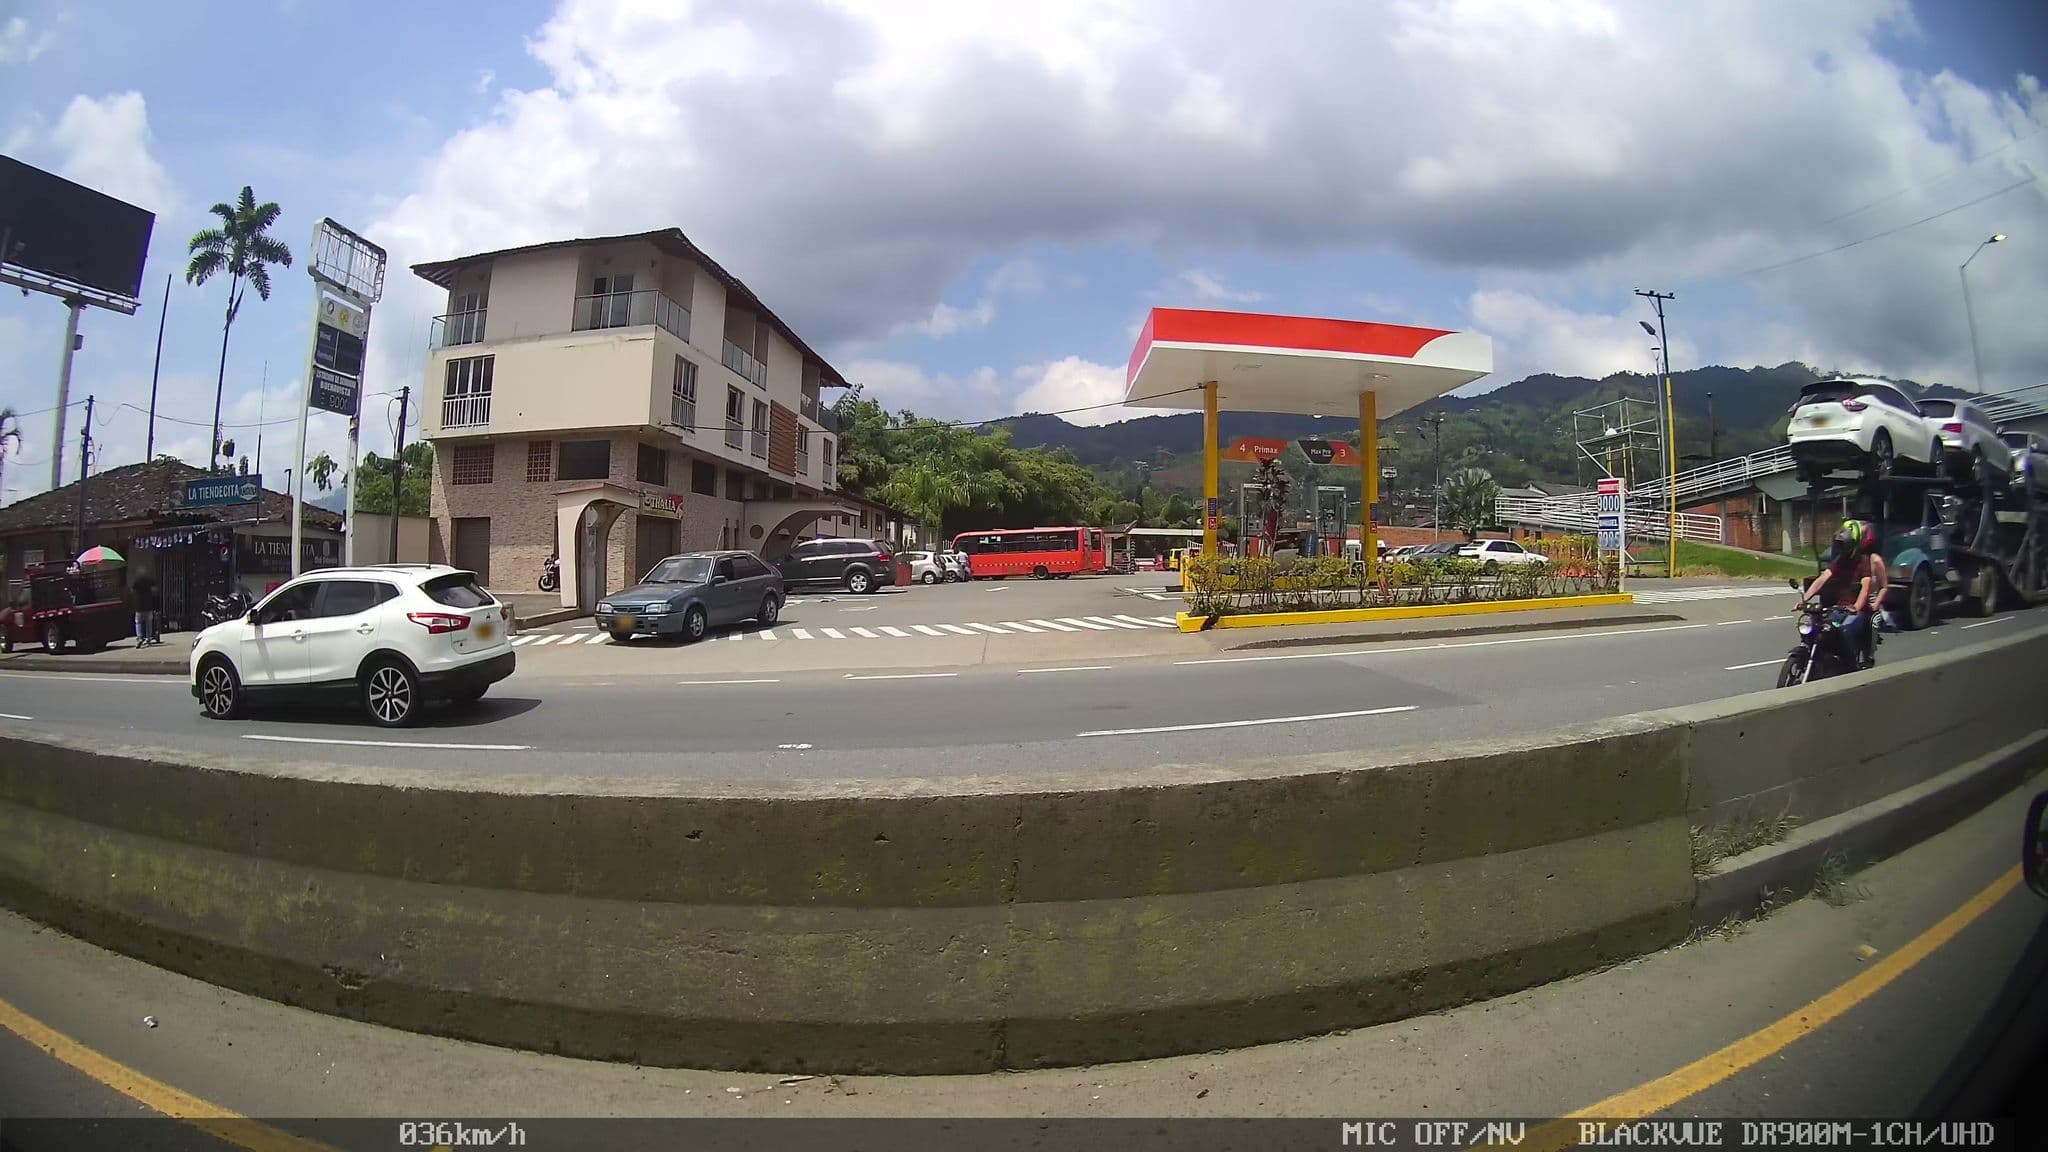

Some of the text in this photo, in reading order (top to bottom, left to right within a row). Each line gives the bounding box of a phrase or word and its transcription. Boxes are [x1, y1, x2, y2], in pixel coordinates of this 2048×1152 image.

[1239, 443, 1246, 453] 4
[1254, 445, 1278, 454] Primax
[1340, 449, 1346, 457] 3
[188, 487, 197, 500] LA
[199, 484, 240, 499] TIENDECITA
[1597, 495, 1620, 511] 9000
[254, 541, 315, 557] LA TIENITA
